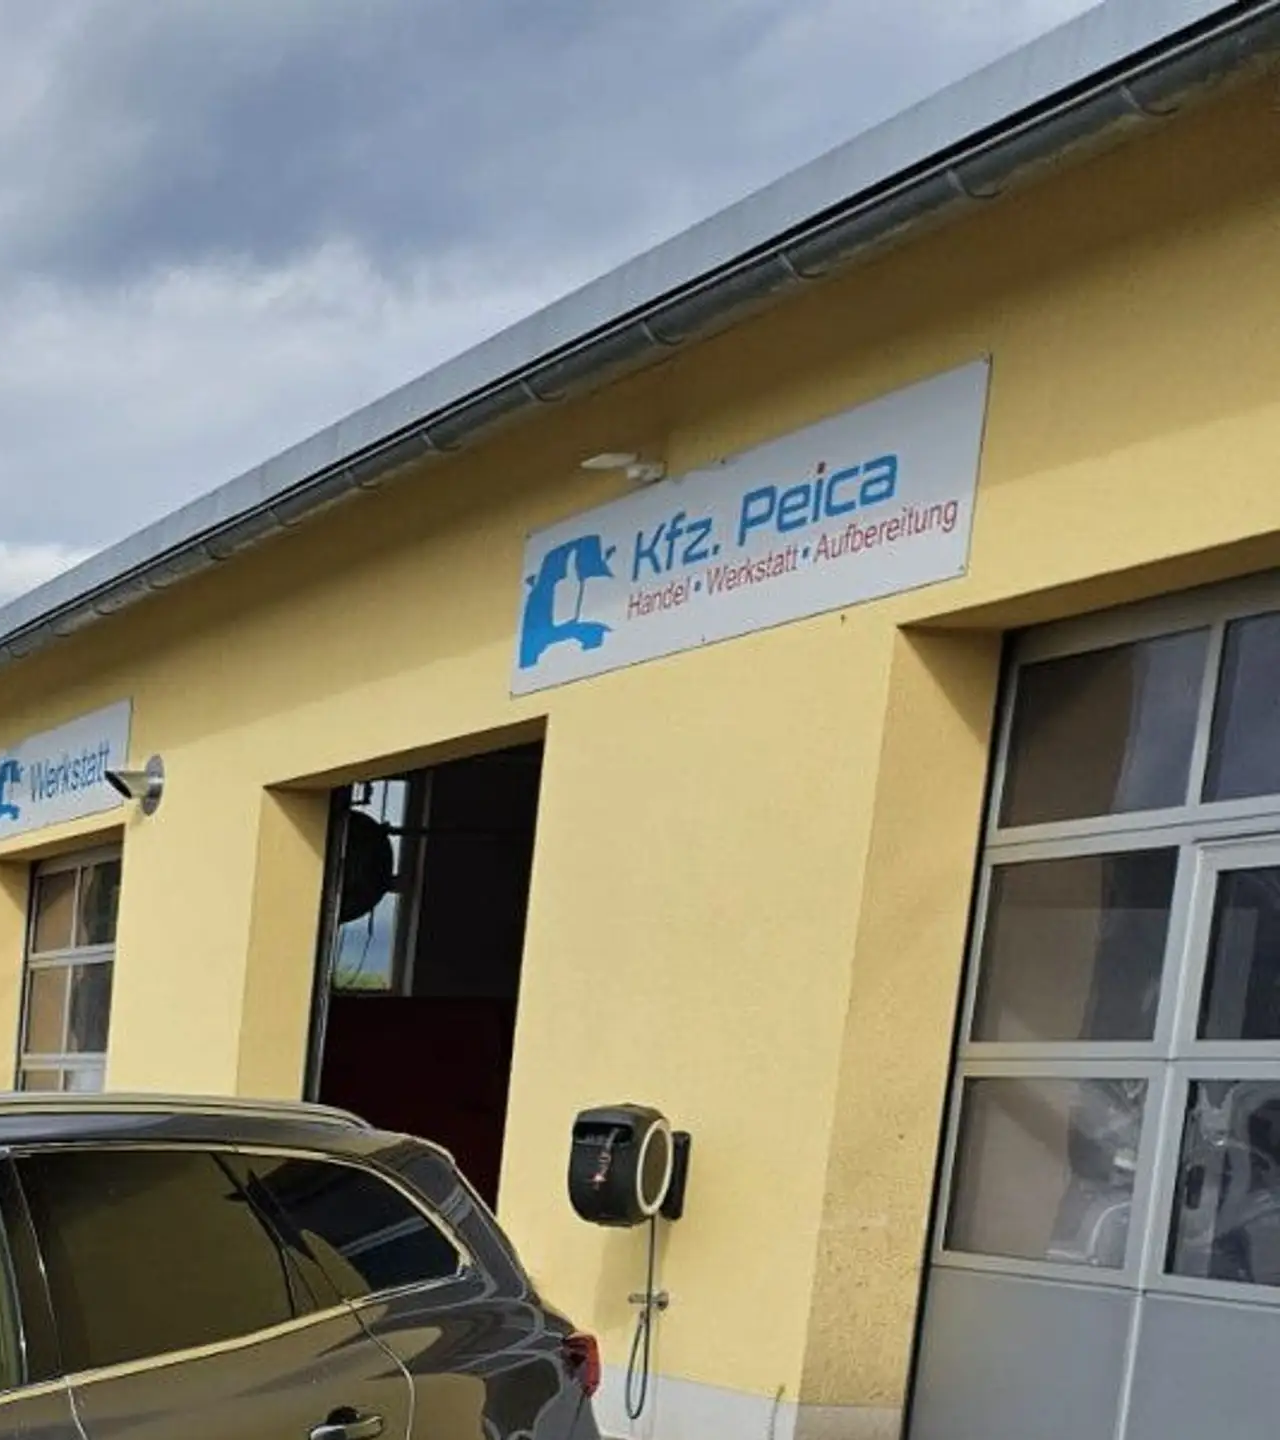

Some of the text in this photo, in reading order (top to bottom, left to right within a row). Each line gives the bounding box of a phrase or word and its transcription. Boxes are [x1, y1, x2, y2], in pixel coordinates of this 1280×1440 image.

[627, 499, 959, 620] Handel Werkstatt Aufbereitung
[632, 453, 898, 582] Kfz. Peica
